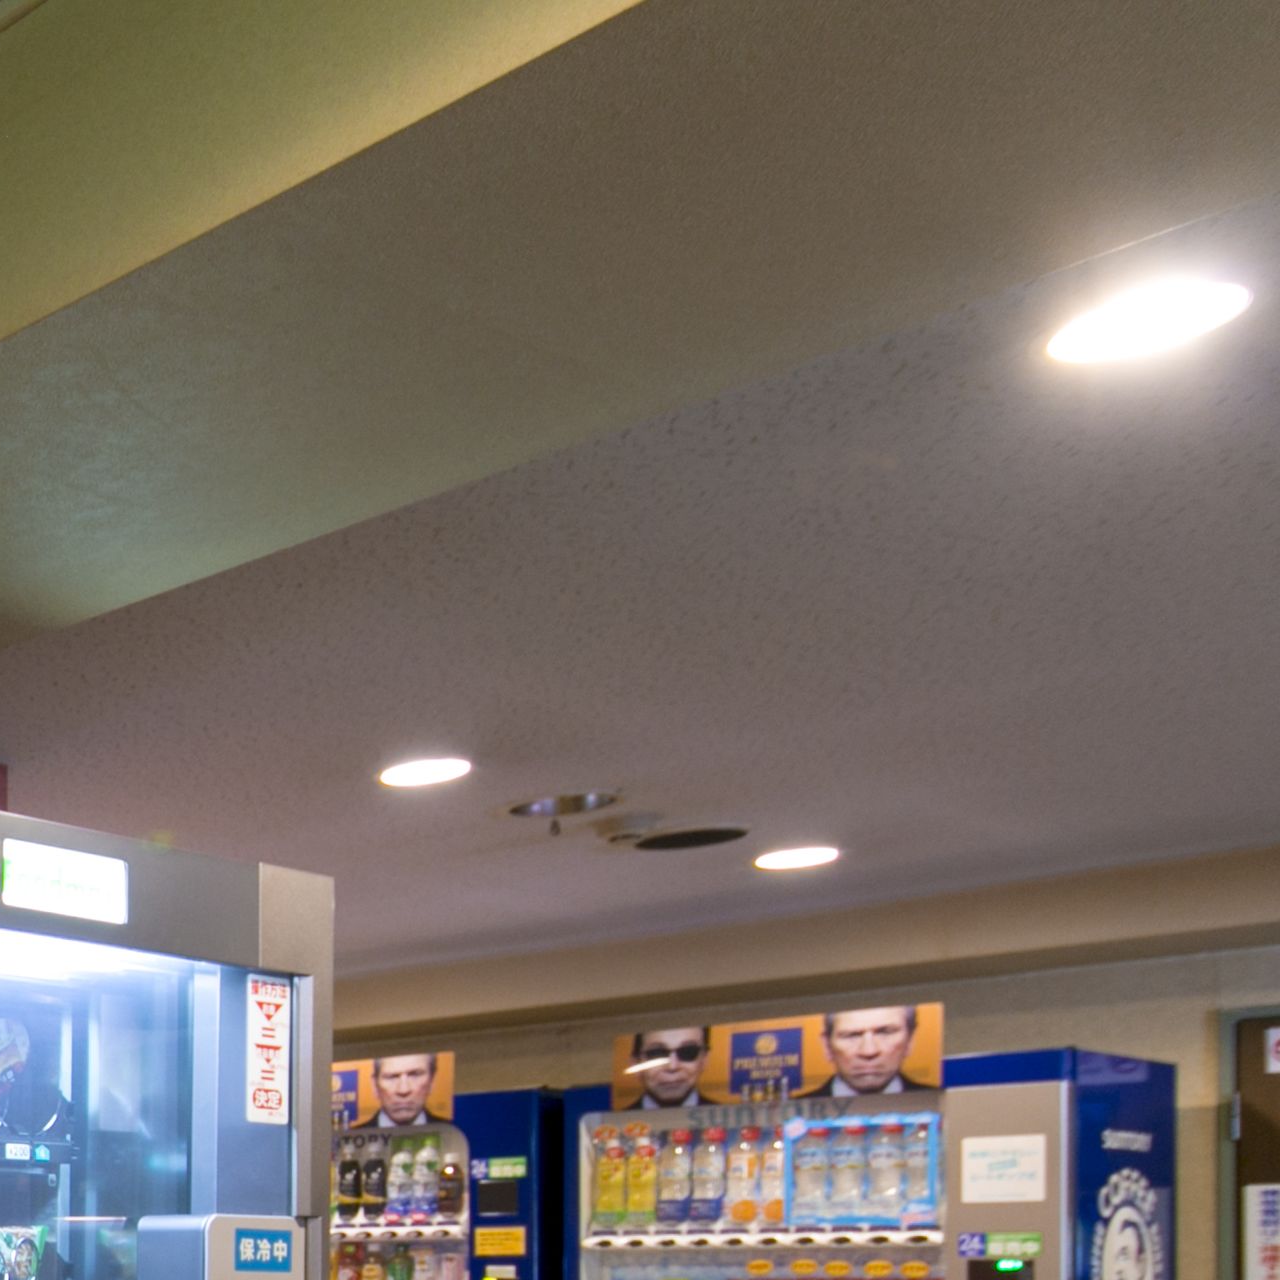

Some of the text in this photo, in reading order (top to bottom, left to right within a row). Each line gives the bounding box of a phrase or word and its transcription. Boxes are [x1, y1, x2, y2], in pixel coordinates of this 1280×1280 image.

[255, 1092, 282, 1109] 決定
[240, 1238, 288, 1262] 保冷中
